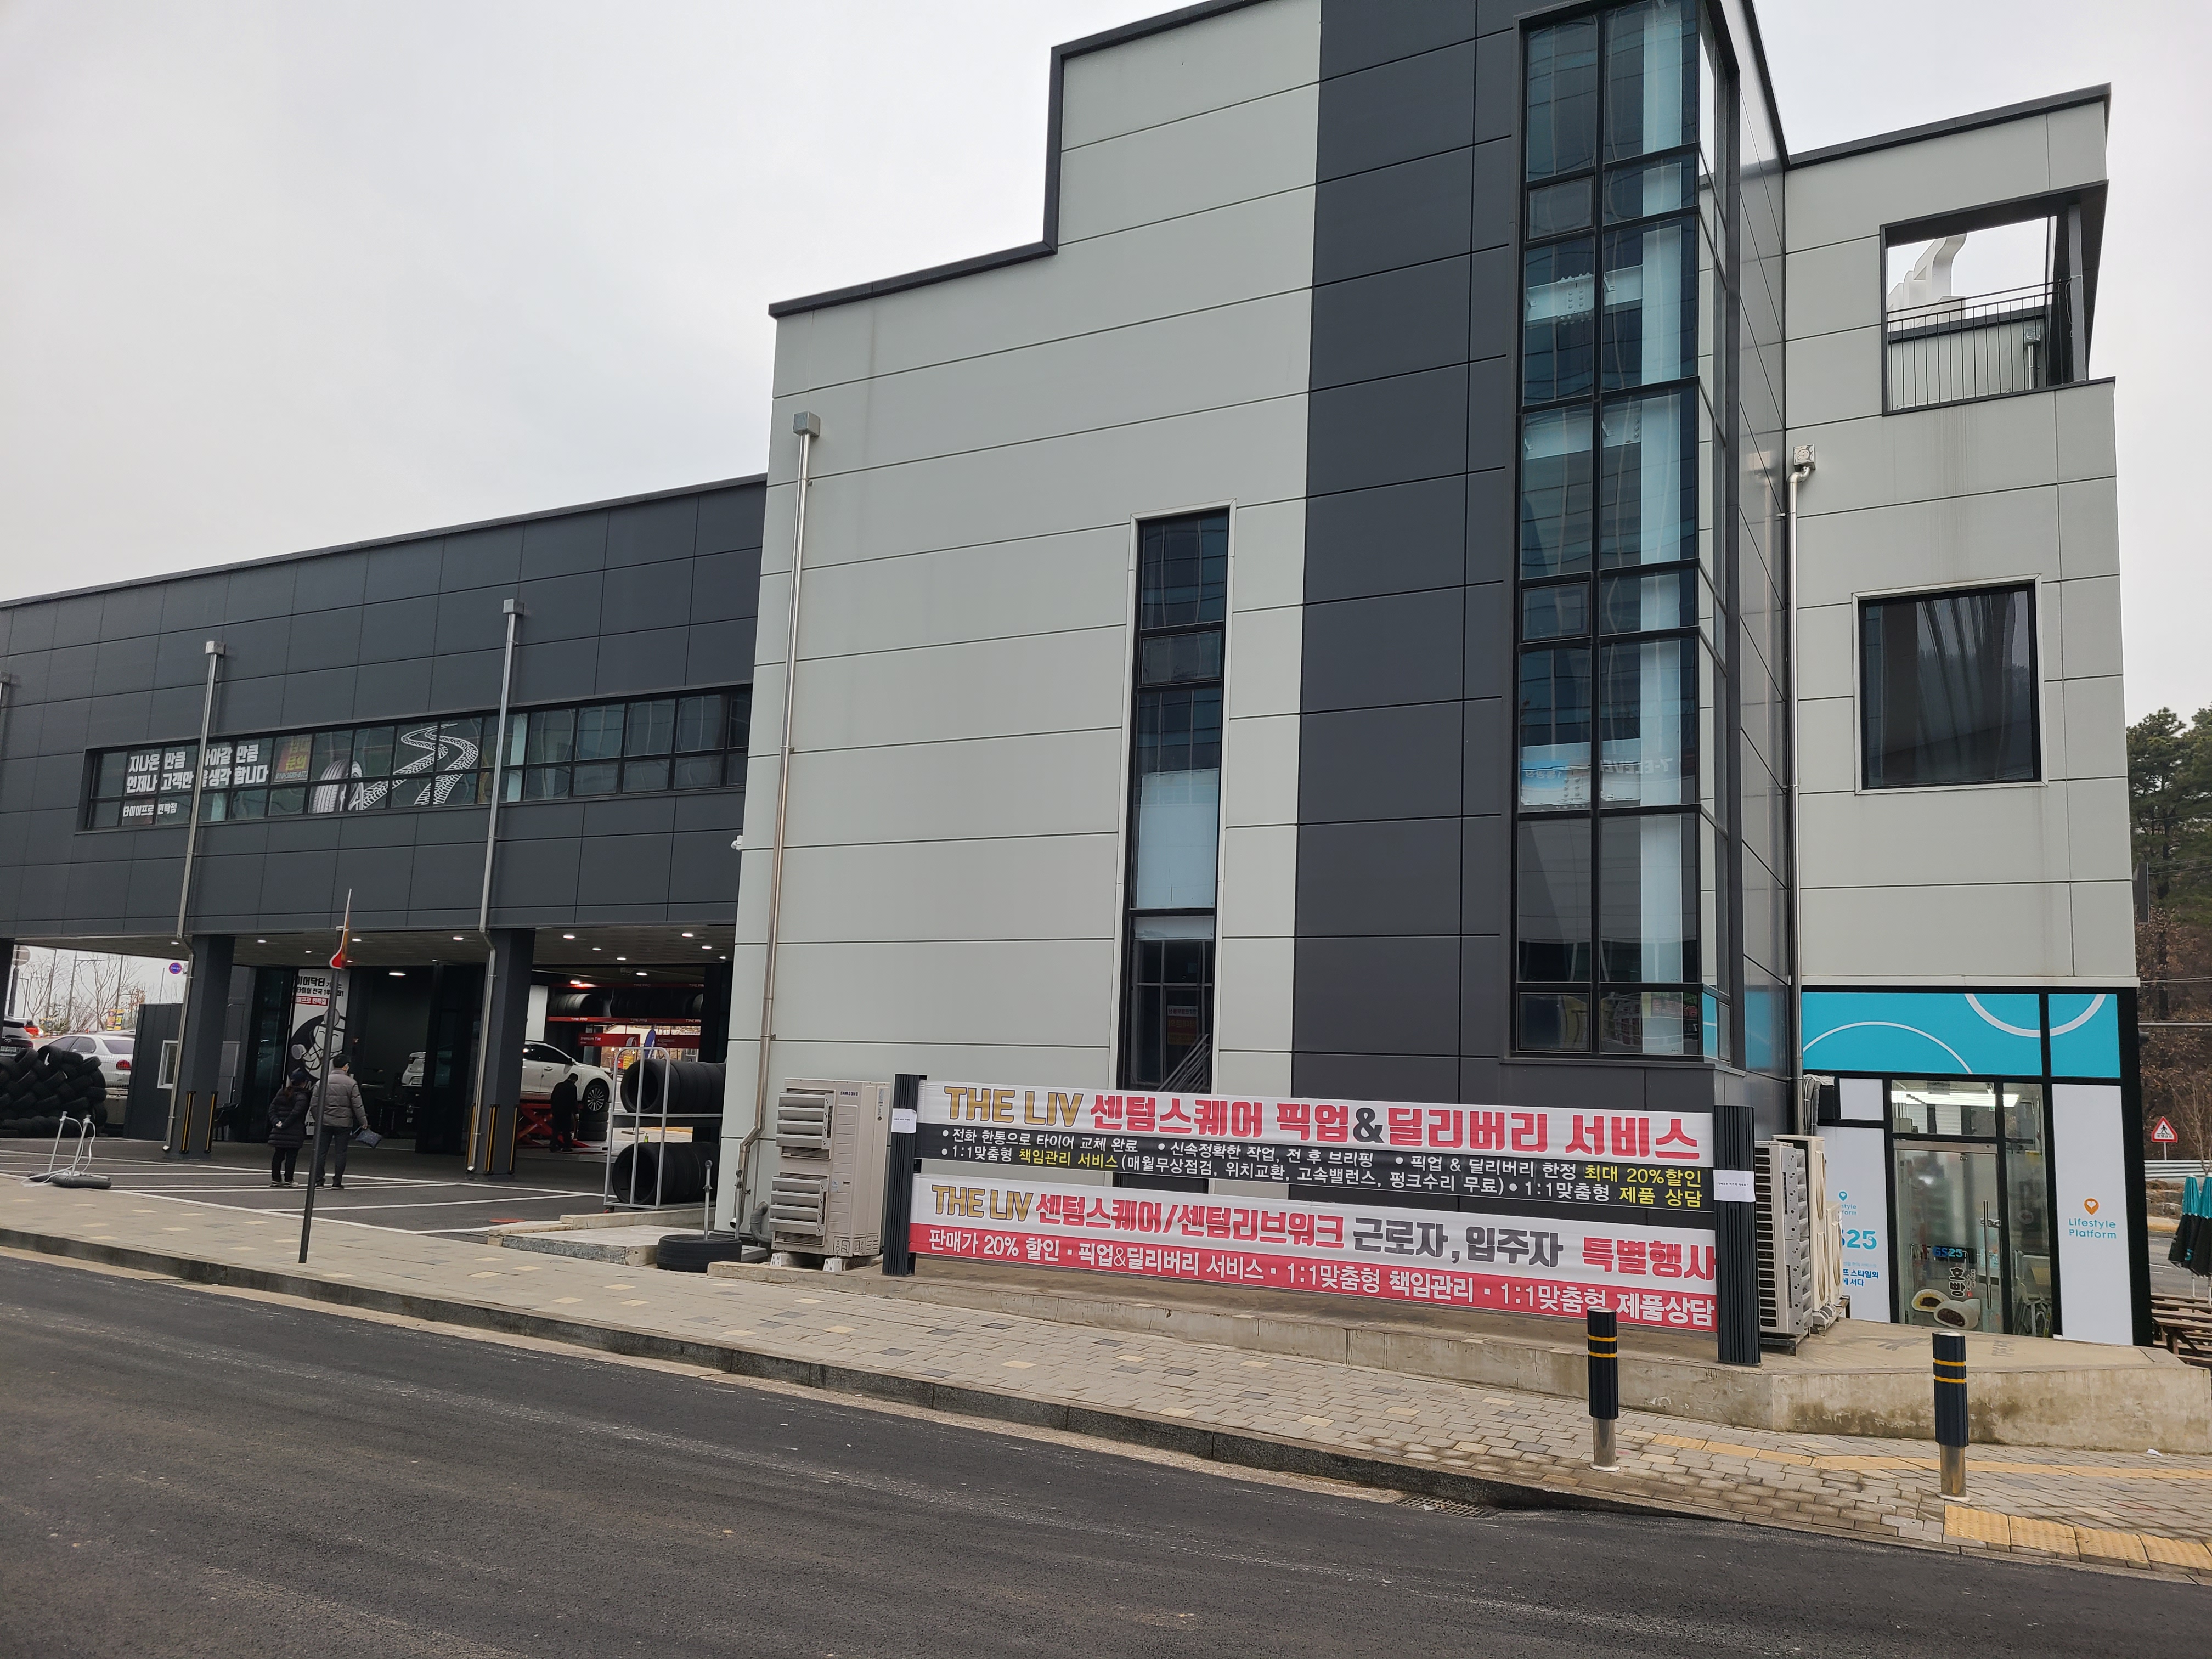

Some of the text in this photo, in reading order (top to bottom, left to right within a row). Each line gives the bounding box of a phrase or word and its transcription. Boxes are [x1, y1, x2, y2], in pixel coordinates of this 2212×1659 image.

[128, 754, 160, 772] 지나온
[164, 751, 186, 770] 만큼
[236, 744, 259, 764] 만큼
[127, 774, 158, 793] 언제나
[209, 768, 232, 786] 생각
[123, 802, 177, 817] 타이어프로 민락점
[944, 1086, 1700, 1160] THE LIV 센텀스퀘어 픽업&딜리버리 서비스
[952, 1128, 977, 1144] 전화
[981, 1130, 1031, 1146] 한통으로
[1036, 1132, 1075, 1149] 타이어
[1080, 1136, 1107, 1151] 교체
[1111, 1137, 1138, 1153] 완료
[1170, 1142, 1242, 1160] 신속정확한
[1246, 1145, 1280, 1164] 작업,
[1327, 1150, 1374, 1167] 브리핑
[1410, 1155, 1443, 1172] 픽업
[1449, 1158, 1462, 1172] &
[1468, 1158, 1535, 1178] 딜리버리
[1542, 1162, 1577, 1180] 한정
[1584, 1165, 1618, 1183] 최대
[1626, 1167, 1702, 1188] 20%할인
[952, 1146, 1702, 1208] 1:1맞춤형 책임관리 서비스 (매월무상점검, 위치교환, 고속밸런스, 펑크수리 무료) 1:1맞춤형 제품 상담
[932, 1184, 985, 1219] THE
[989, 1189, 1034, 1222] LIV
[1582, 1236, 1716, 1281] 특별행사
[2069, 1218, 2116, 1229] Lifestyle
[2069, 1229, 2117, 1239] Platform
[1933, 1246, 1963, 1257] GS25
[929, 1229, 978, 1254] 판매가
[984, 1235, 1019, 1257] 20%
[1025, 1237, 1059, 1262] 할인
[1078, 1242, 1199, 1276] 픽업&딜리버리
[1206, 1255, 1263, 1280] 서비스
[1286, 1262, 1381, 1294] 1:1맞춤형
[1389, 1271, 1474, 1302] 책임관리
[1616, 1293, 1715, 1327] 제품상담
[1850, 1269, 1878, 1279] 스타일의
[1949, 1266, 1966, 1297] 호빵
